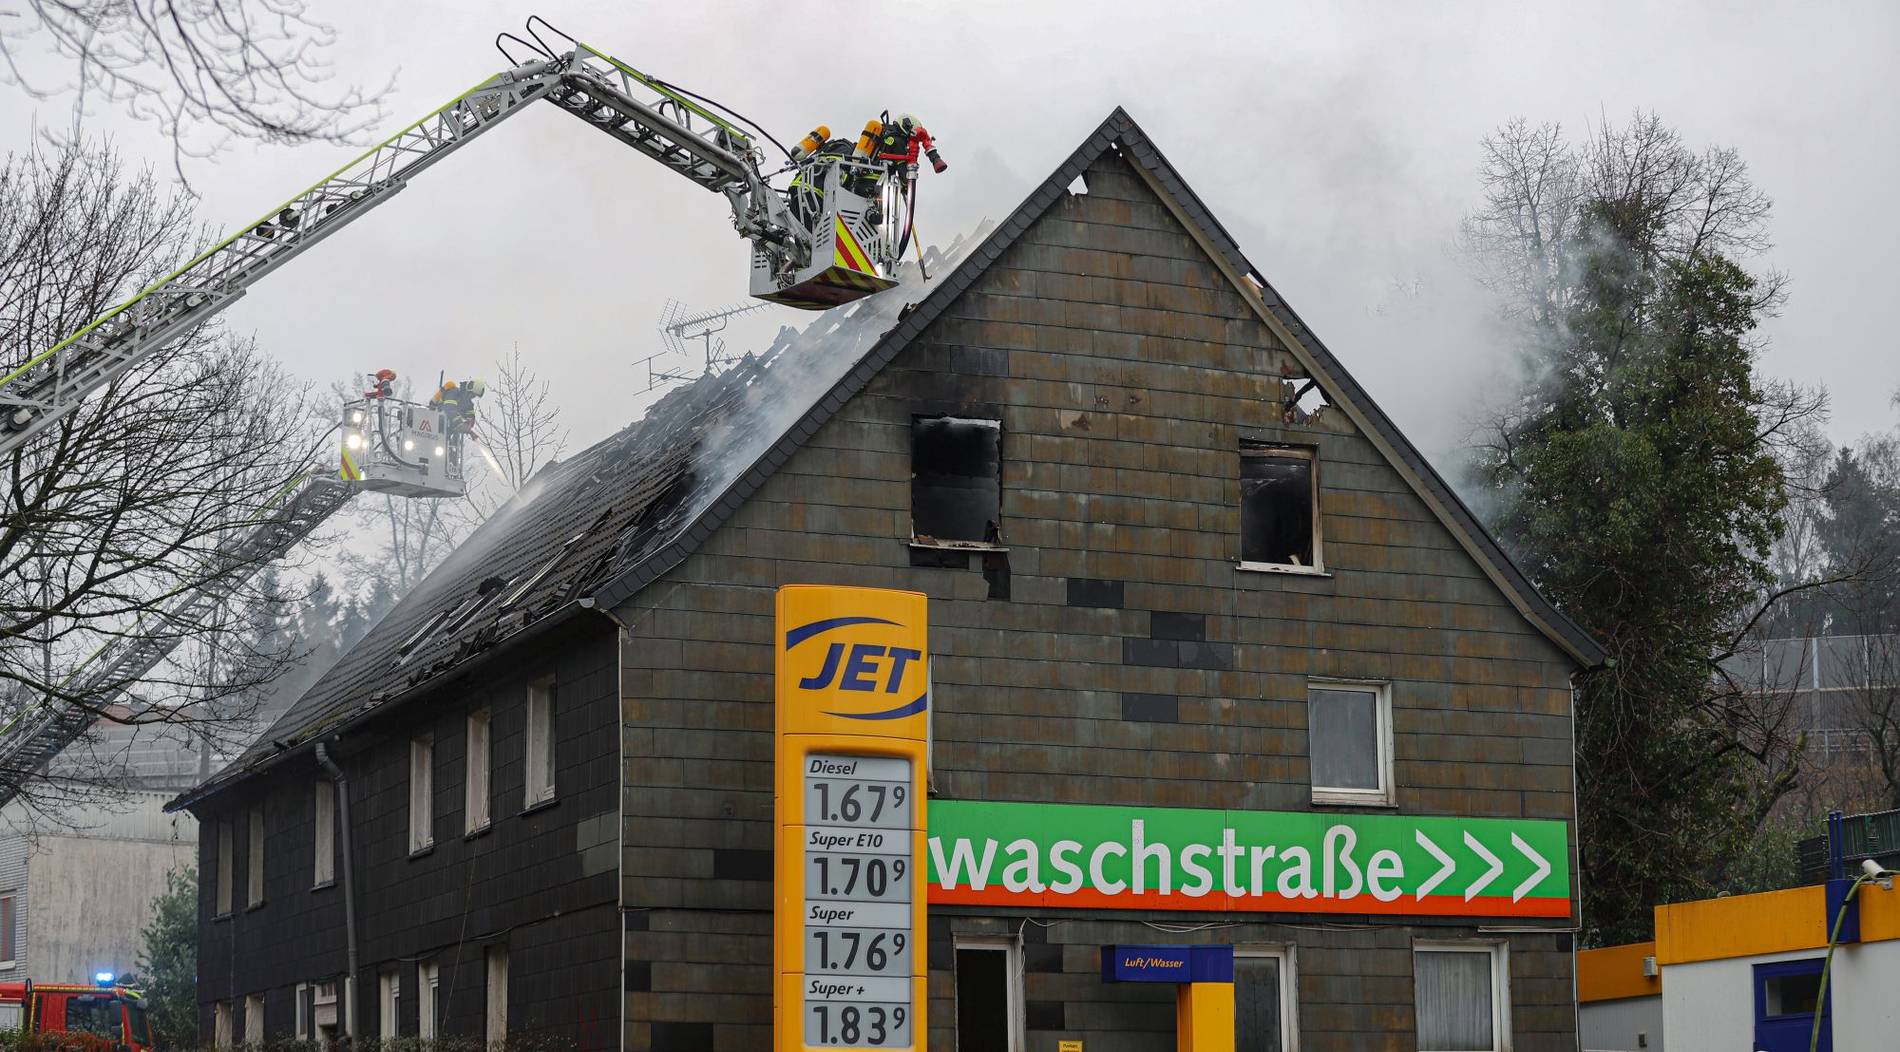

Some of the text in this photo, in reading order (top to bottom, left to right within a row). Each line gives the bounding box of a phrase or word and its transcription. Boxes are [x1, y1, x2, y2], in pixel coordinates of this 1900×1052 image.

[798, 642, 922, 694] JET
[809, 759, 858, 776] Diesel
[809, 831, 884, 850] Super E10
[927, 819, 1405, 903] waschstraße
[809, 905, 855, 925] Super
[1125, 957, 1184, 969] Luft/Wasser
[808, 980, 854, 999] Super
